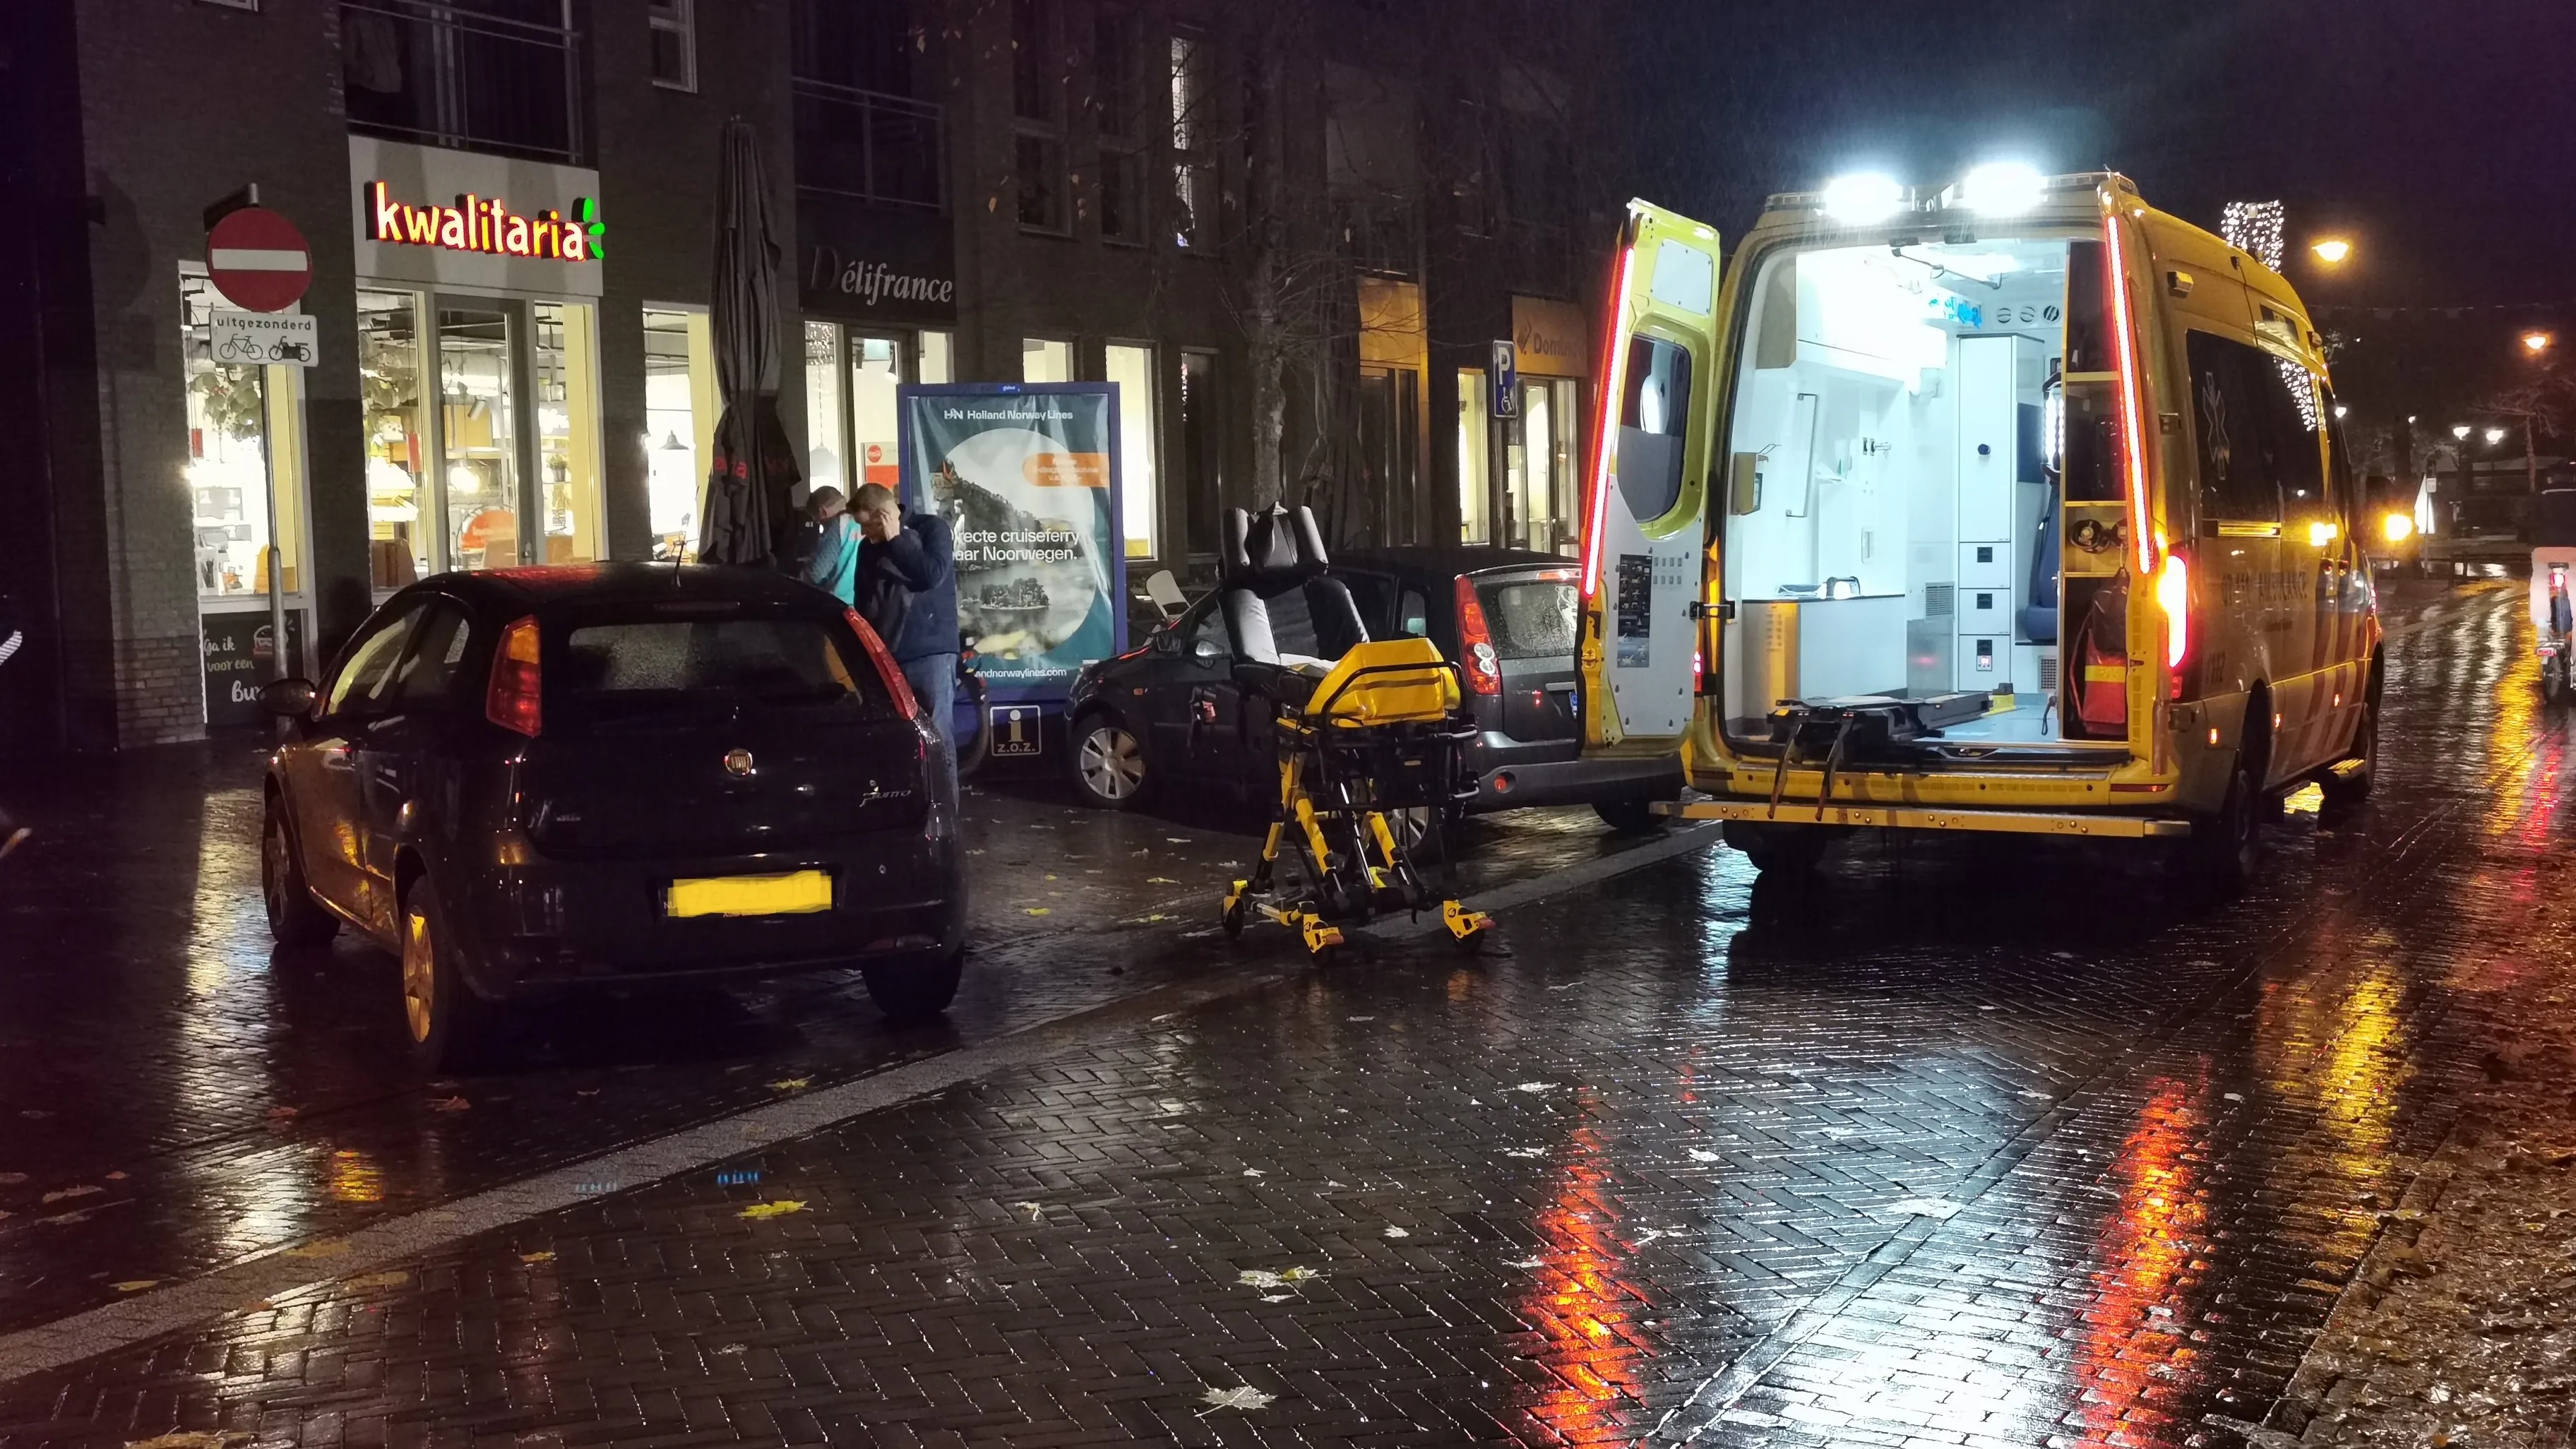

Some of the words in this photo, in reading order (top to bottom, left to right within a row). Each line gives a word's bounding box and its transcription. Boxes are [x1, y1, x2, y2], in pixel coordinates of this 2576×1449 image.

[375, 181, 585, 261] kwalitaria
[807, 245, 953, 306] Délifrance
[217, 316, 311, 330] uitgezonderd
[1498, 347, 1510, 386] P
[967, 410, 1006, 419] Holland
[1008, 410, 1046, 422] Norway
[1047, 410, 1073, 419] Lines
[1001, 527, 1079, 545] cruiseferry
[983, 546, 1078, 564] Noorwegen.
[222, 636, 236, 651] ik
[207, 660, 233, 672] voor
[234, 659, 255, 669] een
